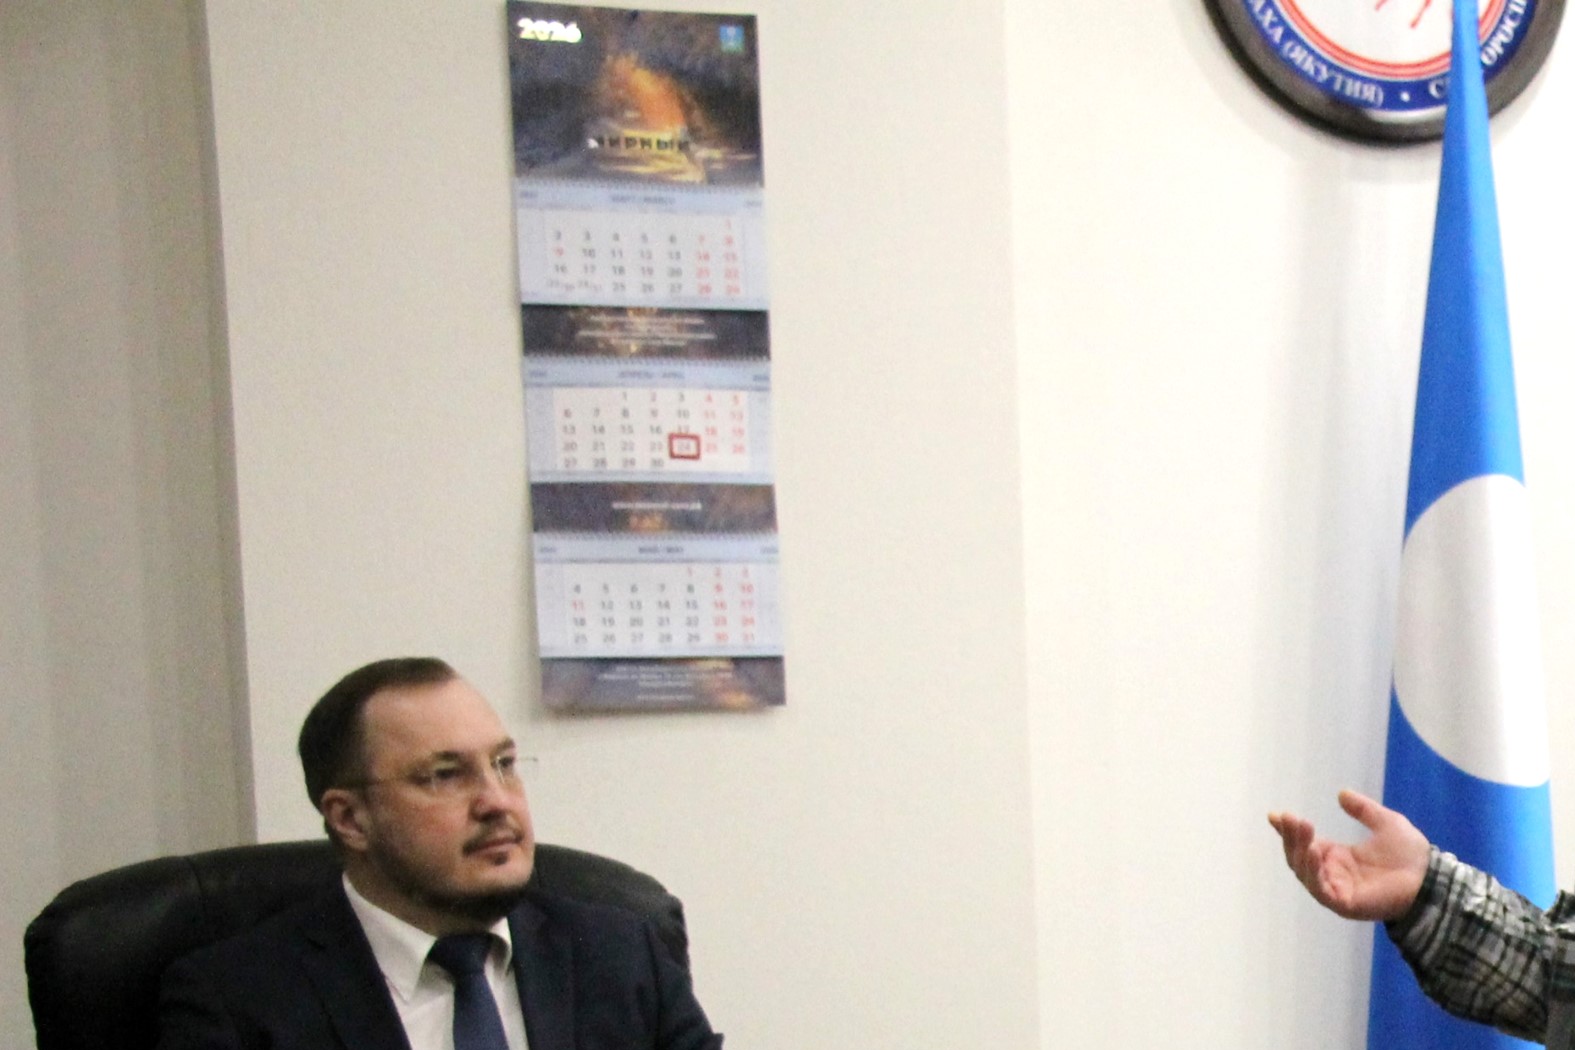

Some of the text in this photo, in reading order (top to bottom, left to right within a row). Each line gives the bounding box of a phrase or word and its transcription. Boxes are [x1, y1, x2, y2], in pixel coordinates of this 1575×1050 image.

[517, 18, 583, 43] 2026
[1250, 0, 1384, 108] АХА (ЯКУТИЯ)
